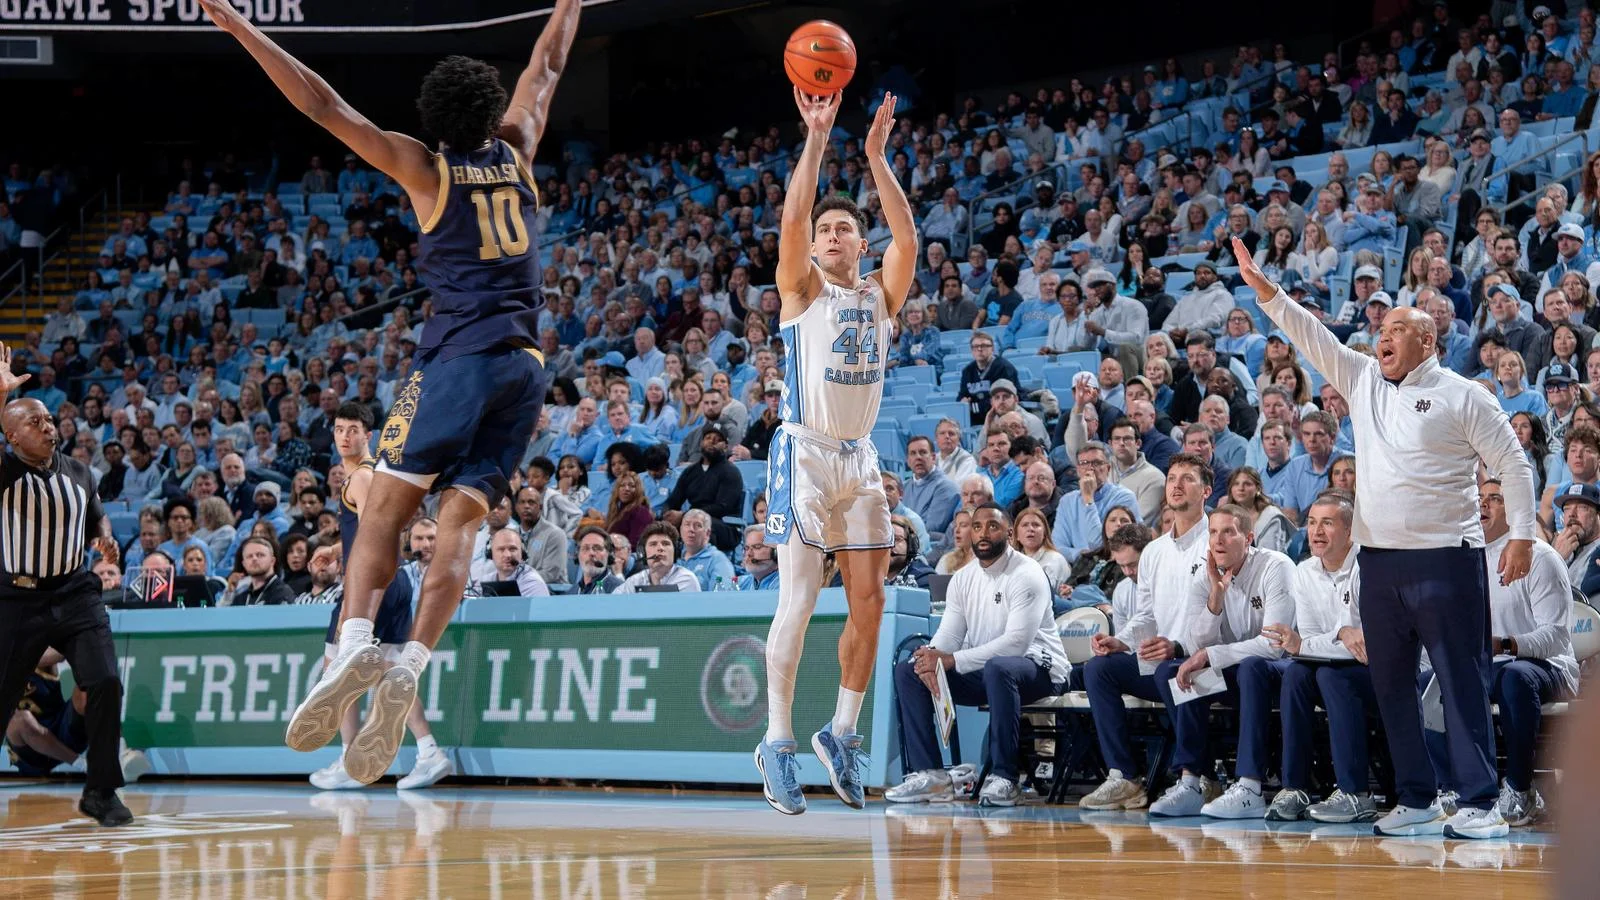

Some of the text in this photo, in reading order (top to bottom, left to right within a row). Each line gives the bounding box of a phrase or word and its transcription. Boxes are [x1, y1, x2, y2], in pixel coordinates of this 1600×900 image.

[0, 0, 304, 21] GAME SPOSOR
[451, 163, 521, 184] HARALS
[470, 186, 529, 260] 10
[832, 326, 880, 364] 44
[155, 651, 456, 722] FREIT
[482, 647, 660, 722] LINE
